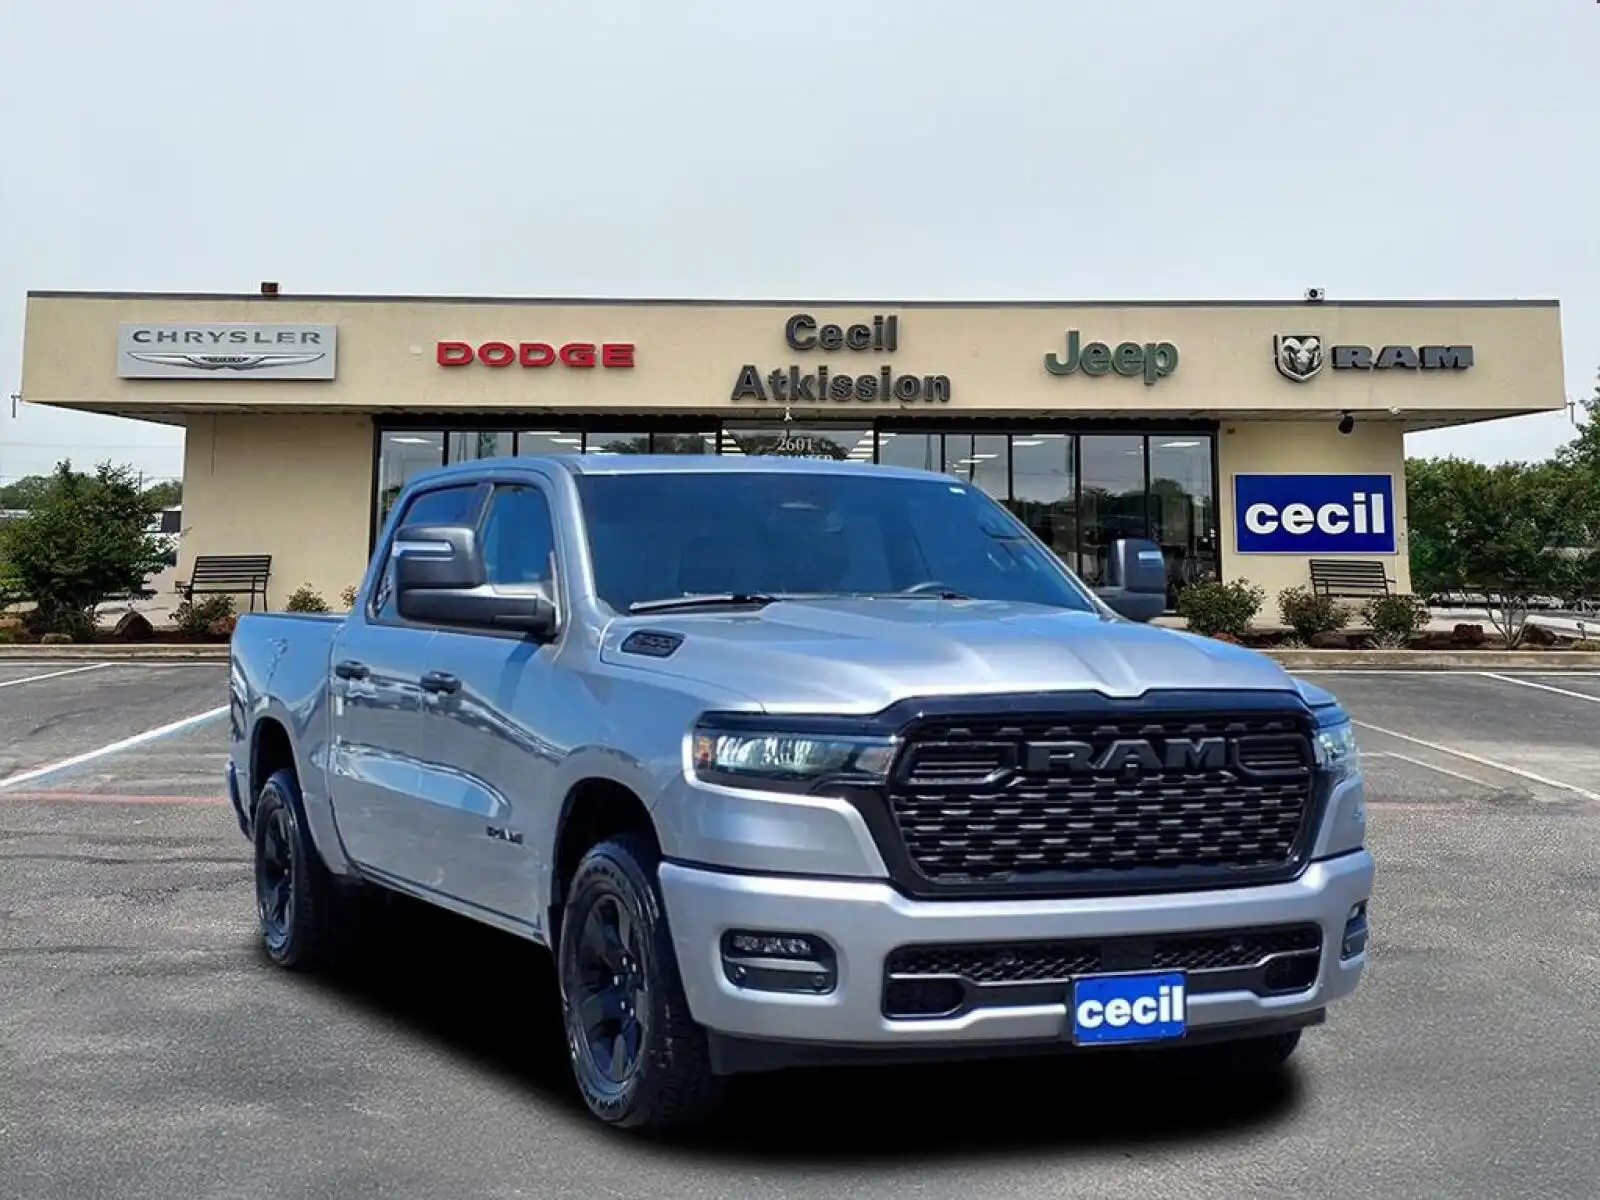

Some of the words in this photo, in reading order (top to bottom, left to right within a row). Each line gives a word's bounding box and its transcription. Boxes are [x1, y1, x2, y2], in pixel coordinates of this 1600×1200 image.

[132, 330, 321, 345] CHRYSLER
[785, 313, 898, 352] Cecil
[436, 341, 635, 368] DODGE
[1045, 330, 1179, 386] Jeep
[1331, 345, 1474, 369] RAM
[730, 364, 951, 402] Atkission
[776, 436, 813, 451] 2601
[1245, 492, 1385, 535] cecil
[1026, 738, 1226, 771] RAM
[1077, 985, 1184, 1028] cecil
